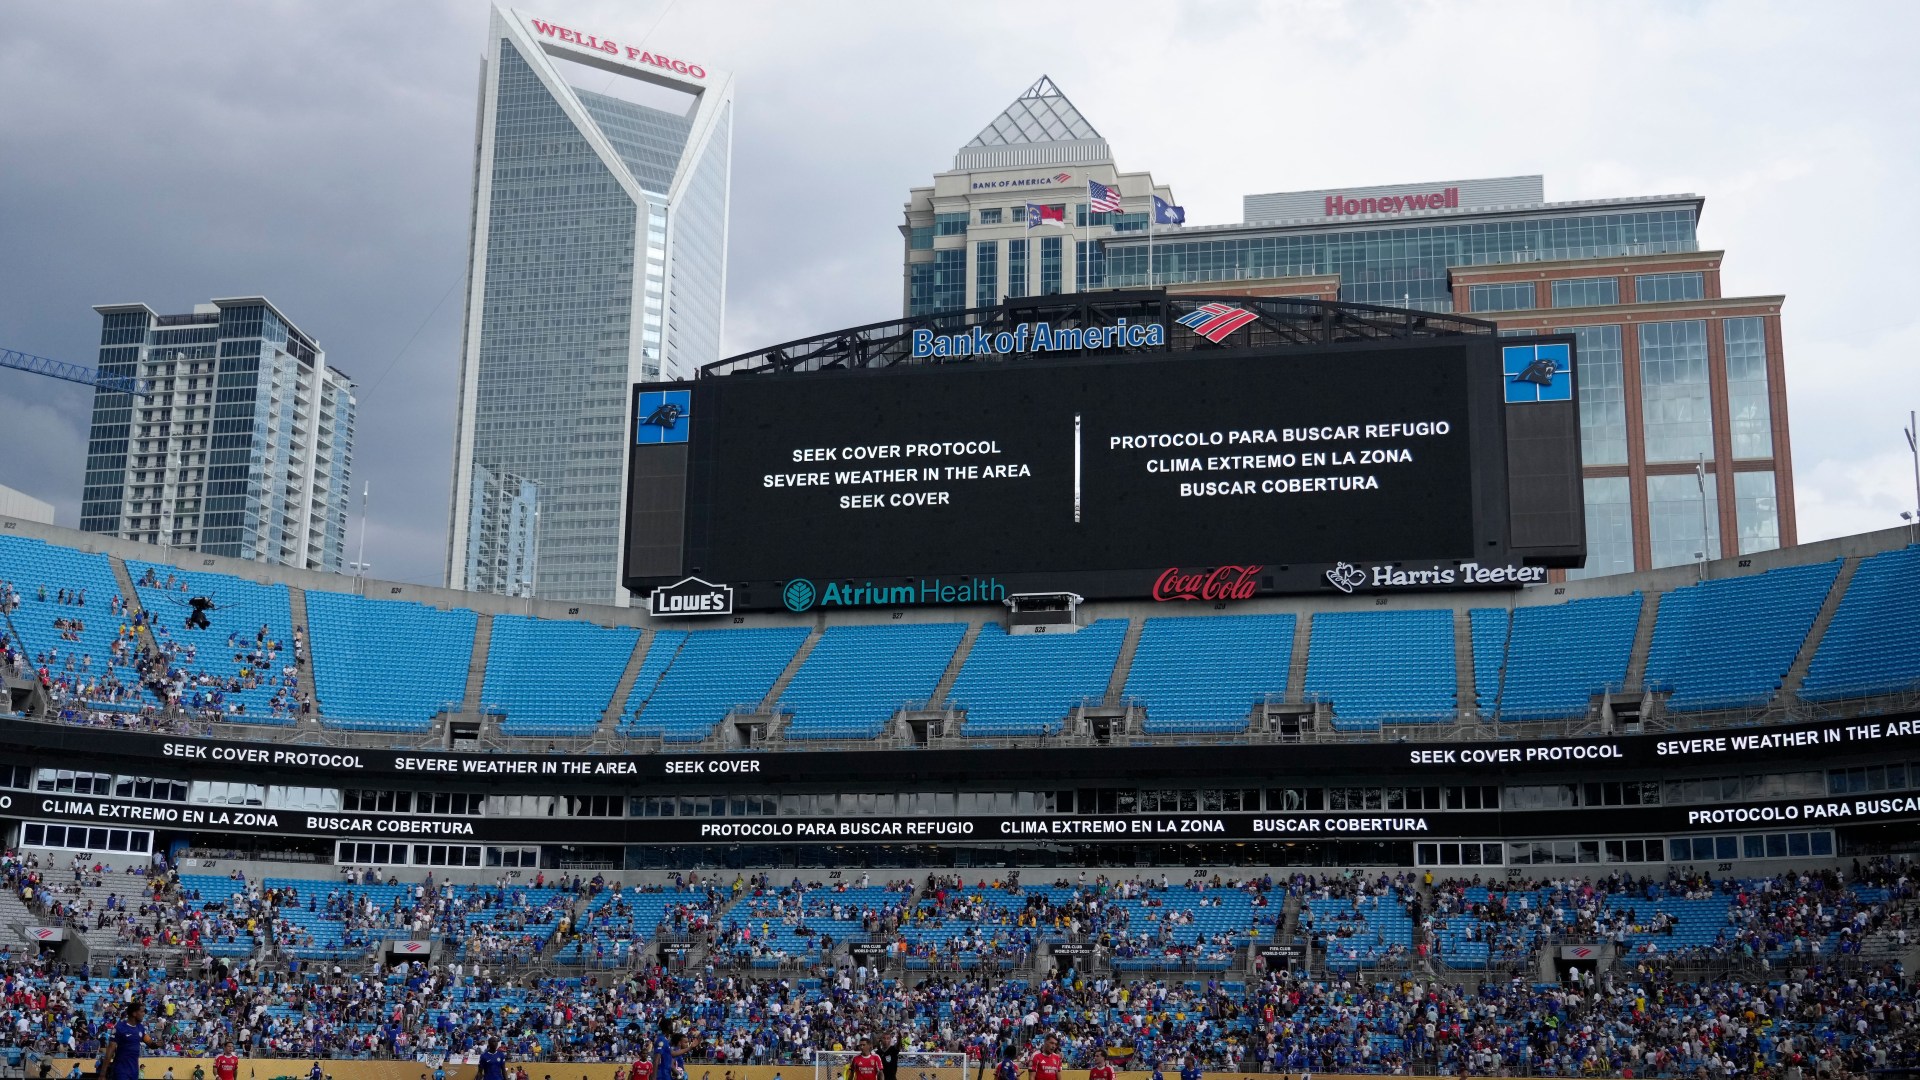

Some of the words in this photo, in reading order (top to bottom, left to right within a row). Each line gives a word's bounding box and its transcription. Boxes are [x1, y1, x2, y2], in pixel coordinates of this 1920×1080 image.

[532, 19, 619, 55] WELLS
[625, 46, 706, 79] FARGO
[973, 181, 997, 189] BANK
[999, 180, 1010, 188] OF
[1011, 178, 1052, 187] AMERICA
[1325, 187, 1459, 216] Honeywell
[912, 326, 991, 358] Bank
[994, 323, 1029, 353] of
[1031, 318, 1165, 352] America
[1110, 431, 1223, 449] PROTOCOLO
[1228, 429, 1277, 444] PARA
[1282, 425, 1359, 441] BUSCAR
[1365, 420, 1449, 438] REFUGIO
[792, 447, 836, 462] SEEK
[841, 444, 900, 459] COVER
[906, 440, 1001, 457] PROTOCOL
[1146, 457, 1202, 472] CLIMA
[1207, 453, 1295, 470] EXTREMO
[1301, 452, 1325, 466] EN
[1331, 451, 1355, 465] LA
[1359, 448, 1412, 464] ZONA
[763, 472, 829, 487] SEVERE
[834, 468, 918, 484] WEATHER
[923, 467, 938, 480] IN
[944, 465, 978, 479] THE
[982, 463, 1031, 478] AREA
[1180, 480, 1256, 496] BUSCAR
[1261, 475, 1378, 493] COBERTURA
[839, 494, 884, 508] SEEK
[889, 491, 949, 506] COVER
[1152, 565, 1263, 602] Coca-Cola
[1372, 565, 1455, 587] Harris
[1459, 562, 1544, 584] Teeter
[659, 592, 724, 612] LOWE'S
[821, 581, 915, 606] Atrium
[920, 577, 1005, 603] Health
[1656, 737, 1726, 755] SEVERE
[1730, 730, 1819, 750] WEATHER
[1823, 728, 1840, 742] IN
[1845, 723, 1881, 740] THE
[1885, 719, 1920, 736] ARE
[162, 742, 207, 758] SEEK
[211, 747, 269, 762] COVER
[274, 751, 363, 767] PROTOCOL
[1410, 750, 1455, 763] SEEK
[1460, 748, 1521, 762] COVER
[1526, 744, 1622, 760] PROTOCOL
[394, 757, 457, 771] SEVERE
[462, 759, 538, 773] WEATHER
[541, 761, 556, 773] IN
[561, 761, 591, 773] THE
[594, 761, 637, 773] AREA
[664, 760, 704, 773] SEEK
[708, 760, 760, 772] COVER
[42, 799, 94, 815] CLIMA
[98, 803, 177, 821] EXTREMO
[182, 809, 204, 822] EN
[209, 811, 229, 824] LA
[233, 812, 278, 826] ZONA
[1688, 805, 1798, 824] PROTOCOLO
[1803, 802, 1851, 818] PARA
[306, 816, 372, 831] BUSCAR
[376, 819, 473, 834] COBERTURA
[701, 823, 792, 835] PROTOCOLO
[796, 822, 836, 835] PARA
[840, 822, 902, 834] BUSCAR
[906, 821, 973, 834] REFUGIO
[1000, 820, 1048, 833] CLIMA
[1052, 820, 1126, 832] EXTREMO
[1131, 820, 1151, 832] EN
[1157, 819, 1177, 832] LA
[1180, 819, 1224, 832] ZONA
[1253, 818, 1320, 831] BUSCAR
[1324, 817, 1427, 831] COBERTURA
[1194, 870, 1208, 878] 230
